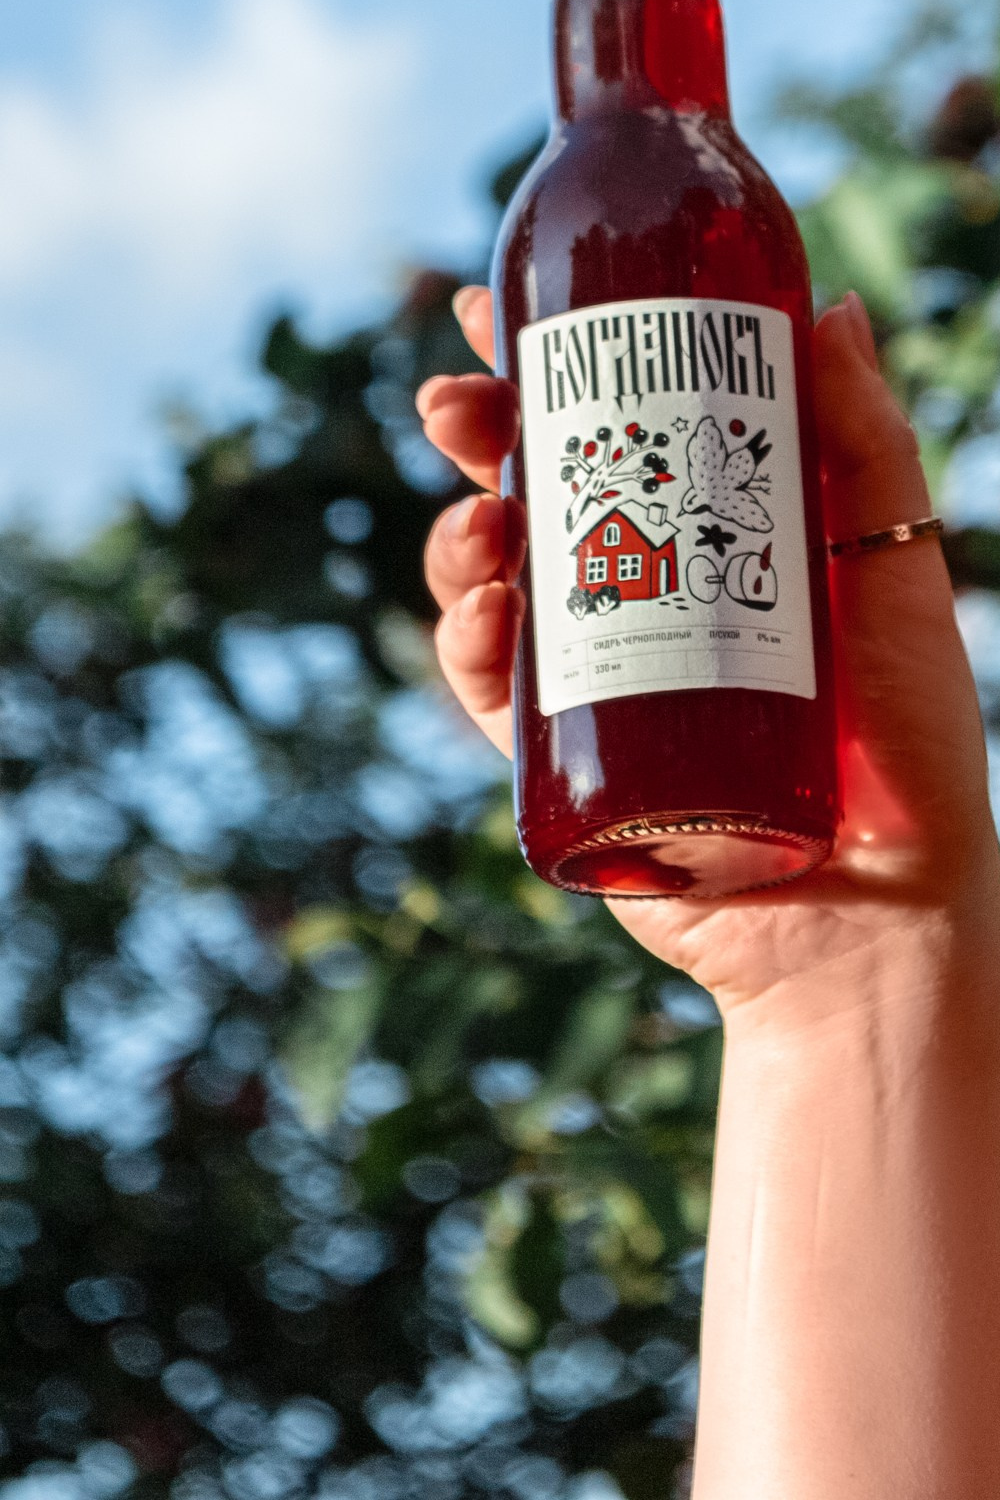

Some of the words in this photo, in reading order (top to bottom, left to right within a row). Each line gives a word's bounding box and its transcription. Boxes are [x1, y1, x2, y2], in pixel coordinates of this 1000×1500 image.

[623, 630, 692, 646] ЧЕРНОПЛОДНЫЙ
[709, 630, 740, 640] П/СУХОЙ
[595, 663, 610, 675] 330
[611, 663, 622, 671] мл
